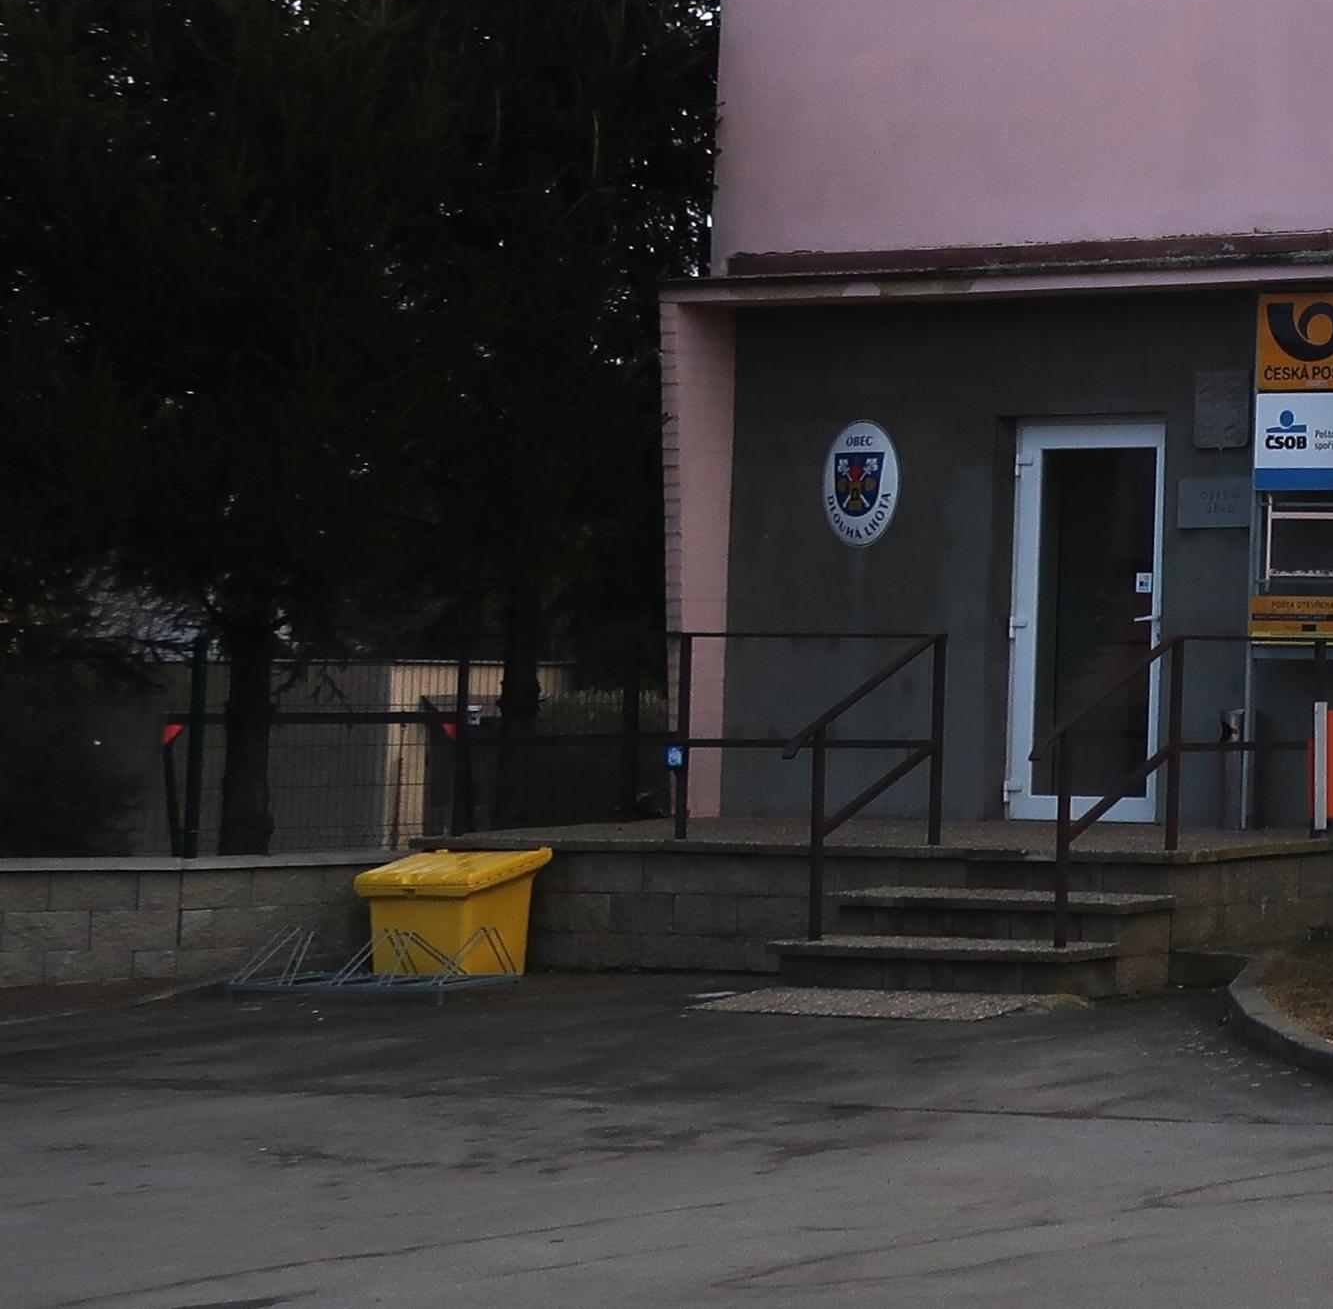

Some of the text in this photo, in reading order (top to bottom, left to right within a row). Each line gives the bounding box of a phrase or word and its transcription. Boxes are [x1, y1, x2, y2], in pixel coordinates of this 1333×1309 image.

[1264, 365, 1308, 381] ČESKÁ
[845, 435, 874, 447] OBEC
[1265, 435, 1307, 450] ČSOB
[864, 492, 892, 537] LHOTA
